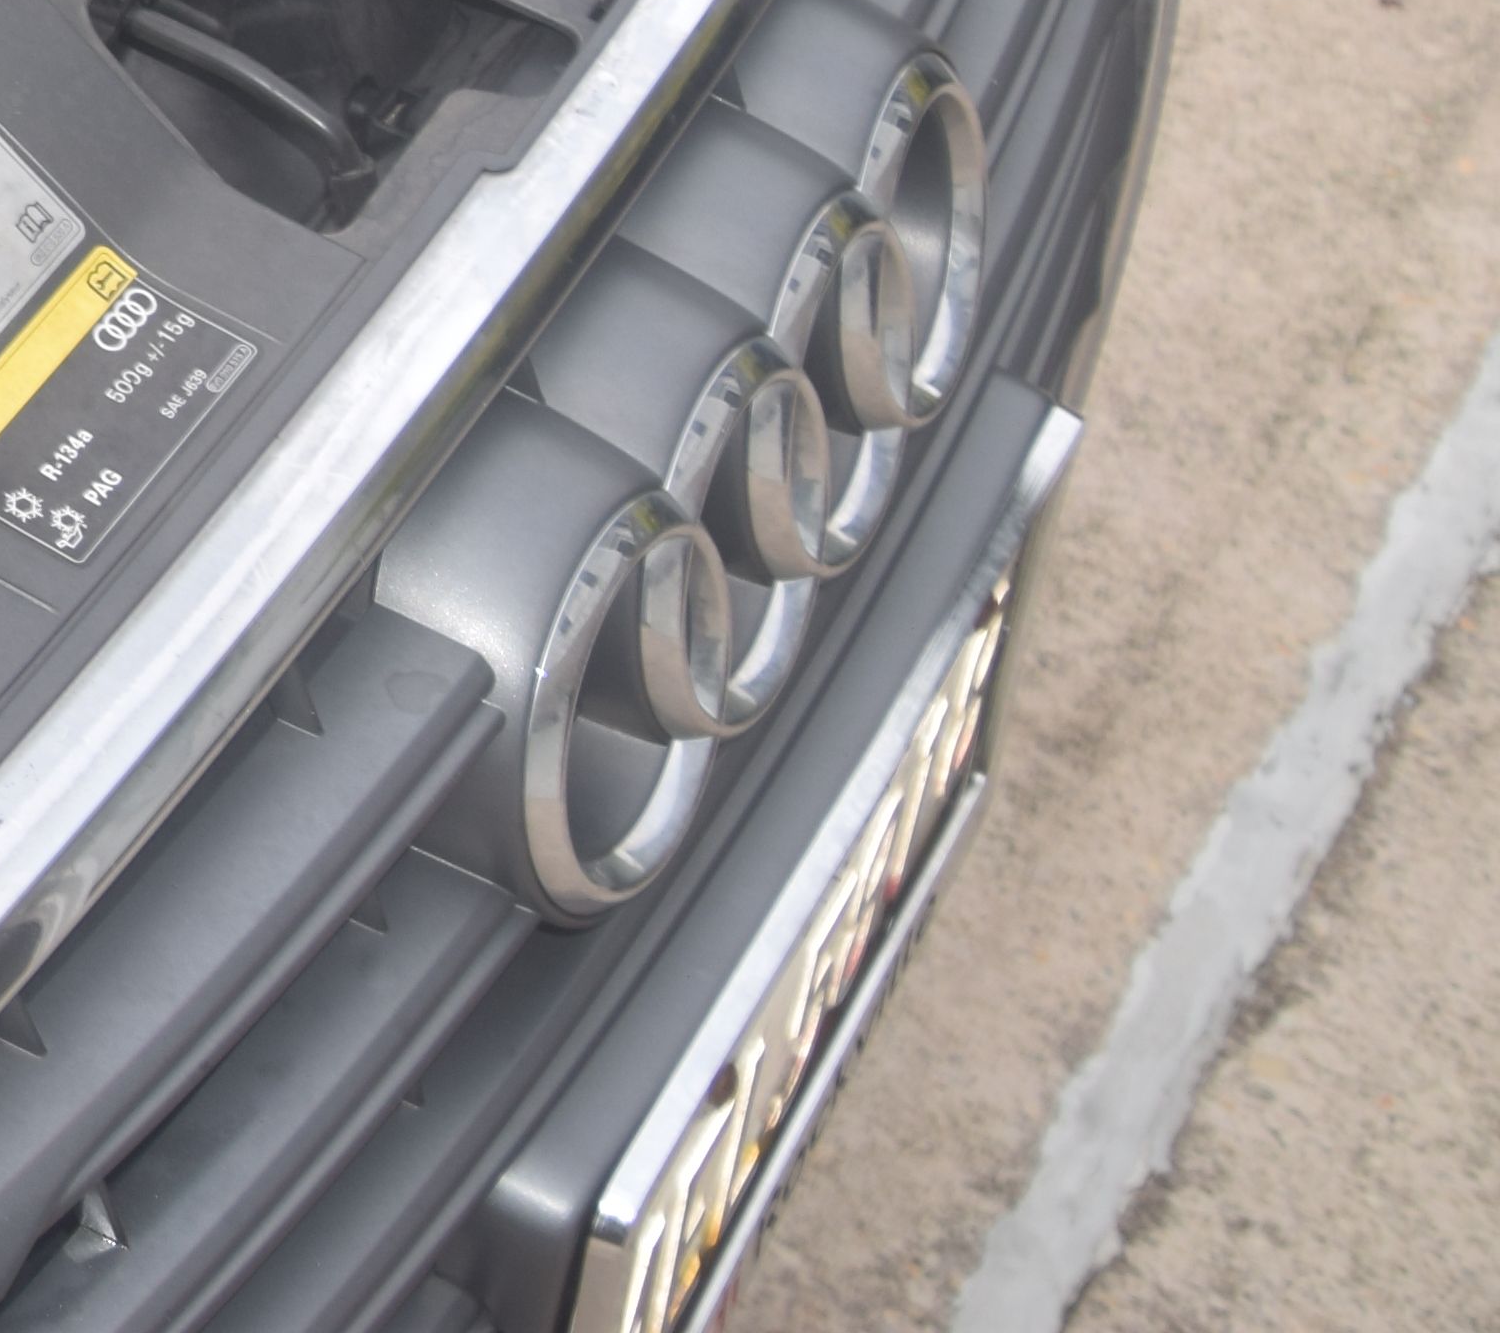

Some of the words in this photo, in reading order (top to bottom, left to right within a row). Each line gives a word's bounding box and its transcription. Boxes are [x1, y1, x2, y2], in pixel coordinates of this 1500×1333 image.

[37, 424, 96, 483] R-134a
[103, 358, 155, 408] 500g
[82, 466, 124, 507] PAG
[159, 394, 186, 420] SAE
[178, 366, 209, 397] J639
